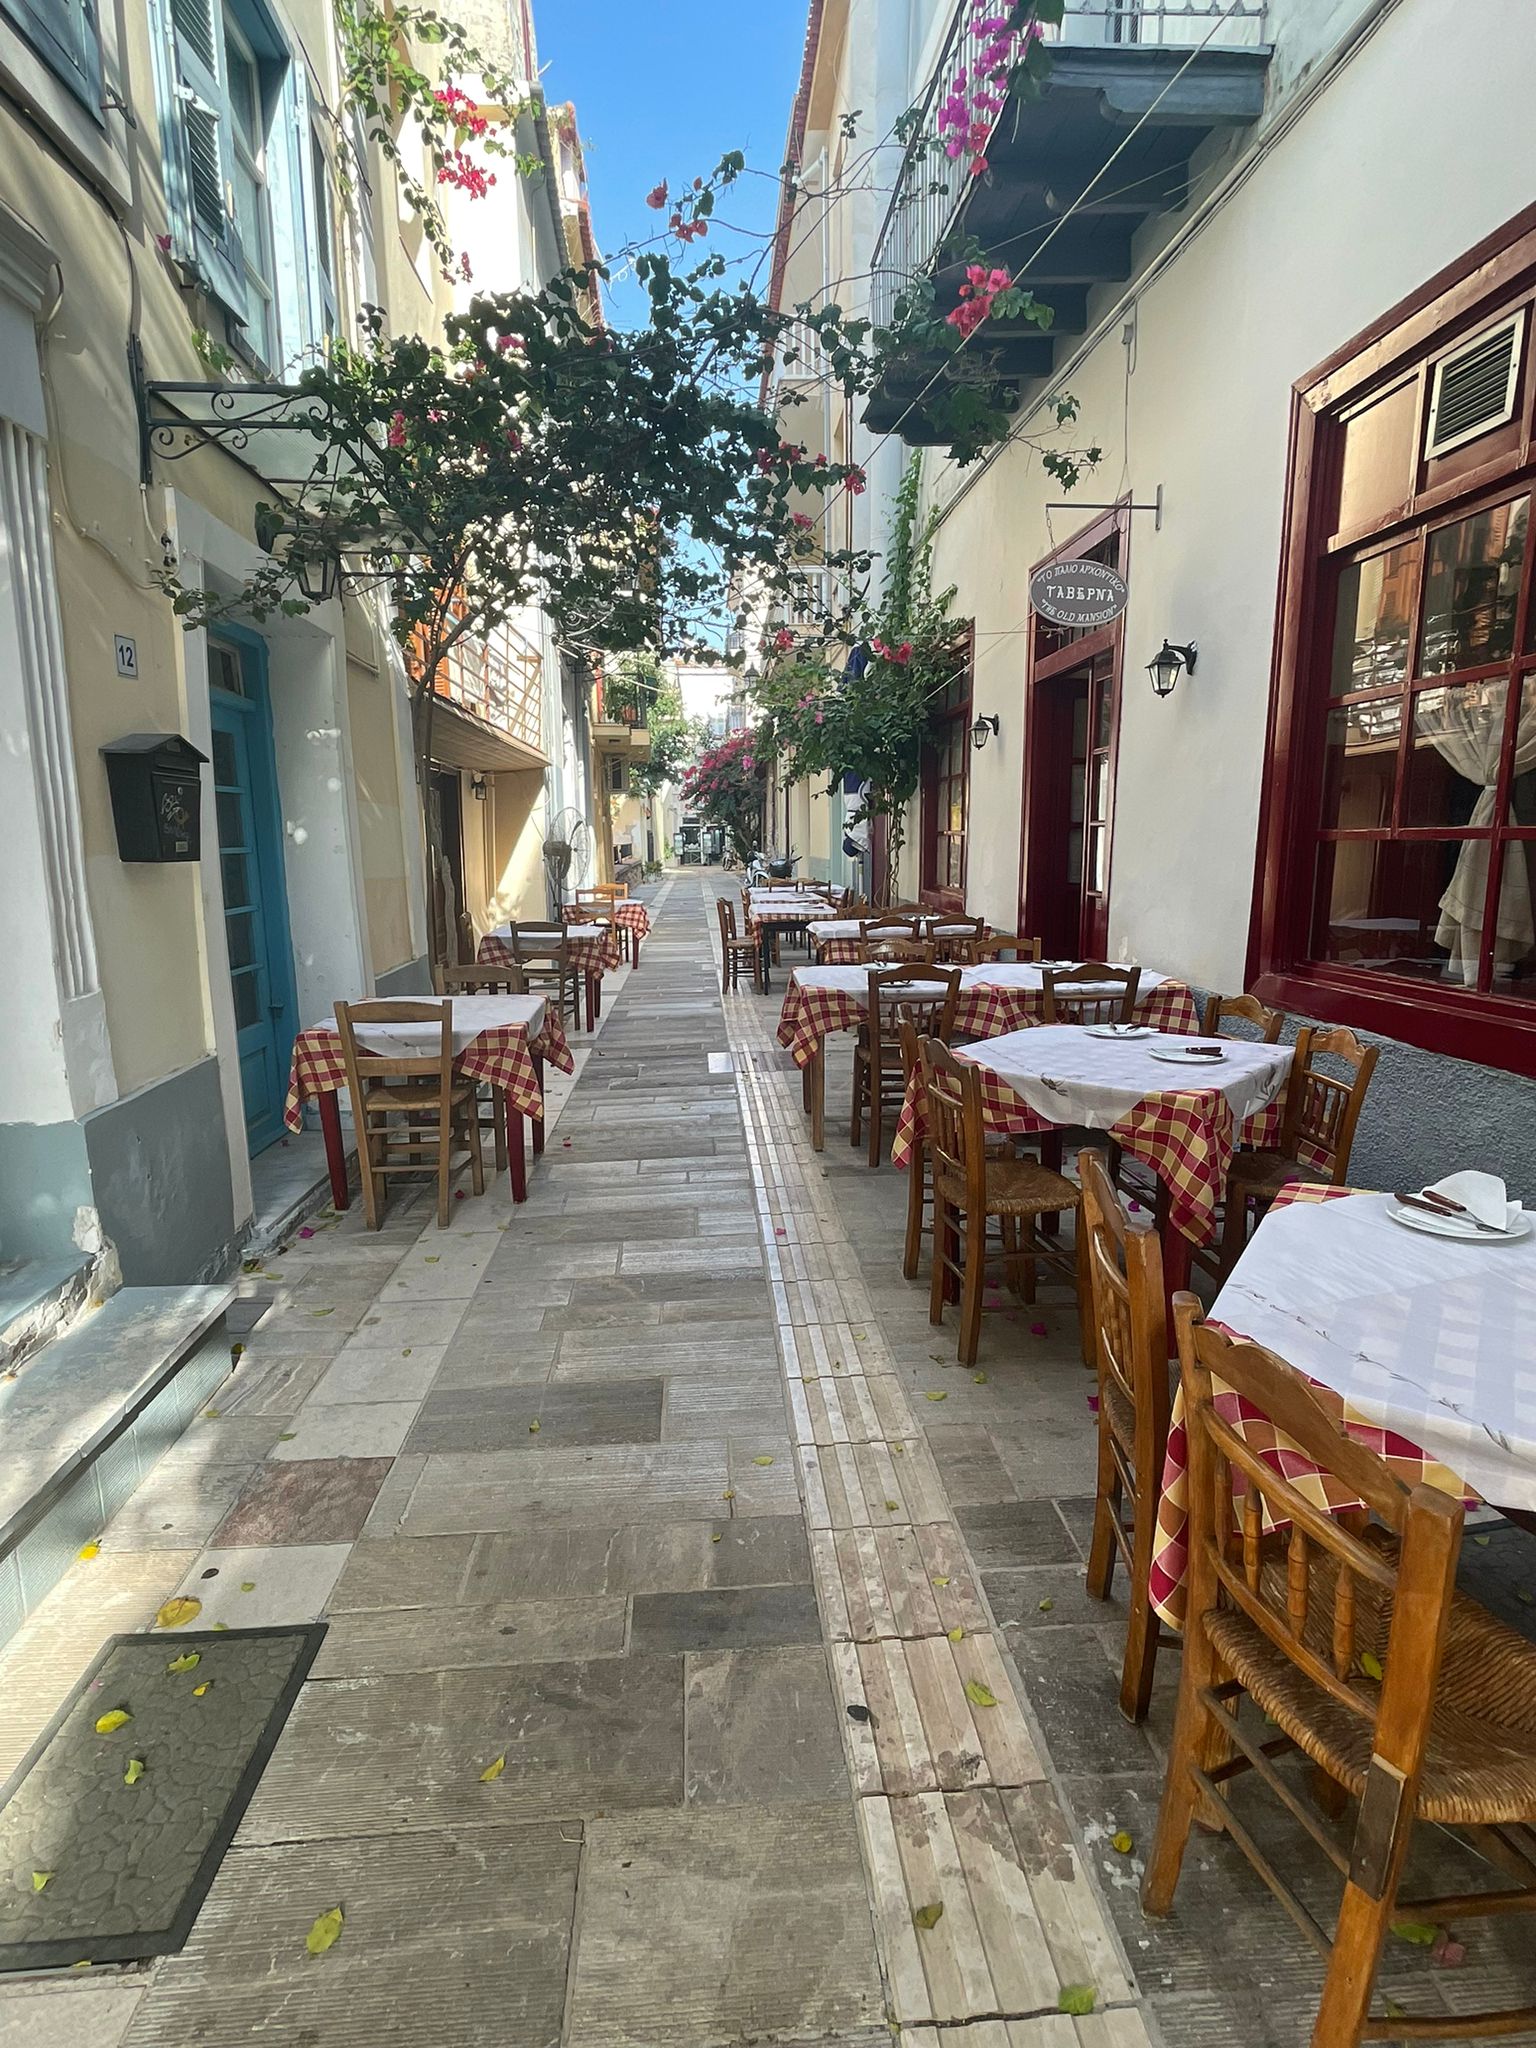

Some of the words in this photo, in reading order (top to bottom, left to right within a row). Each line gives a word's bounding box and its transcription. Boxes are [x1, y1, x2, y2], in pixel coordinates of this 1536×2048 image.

[1054, 564, 1079, 577] ΠΑΛΙΟ
[1046, 585, 1114, 602] ΤΑΒΕΡΝΑ
[1057, 610, 1076, 622] OLD
[118, 644, 134, 668] 12
